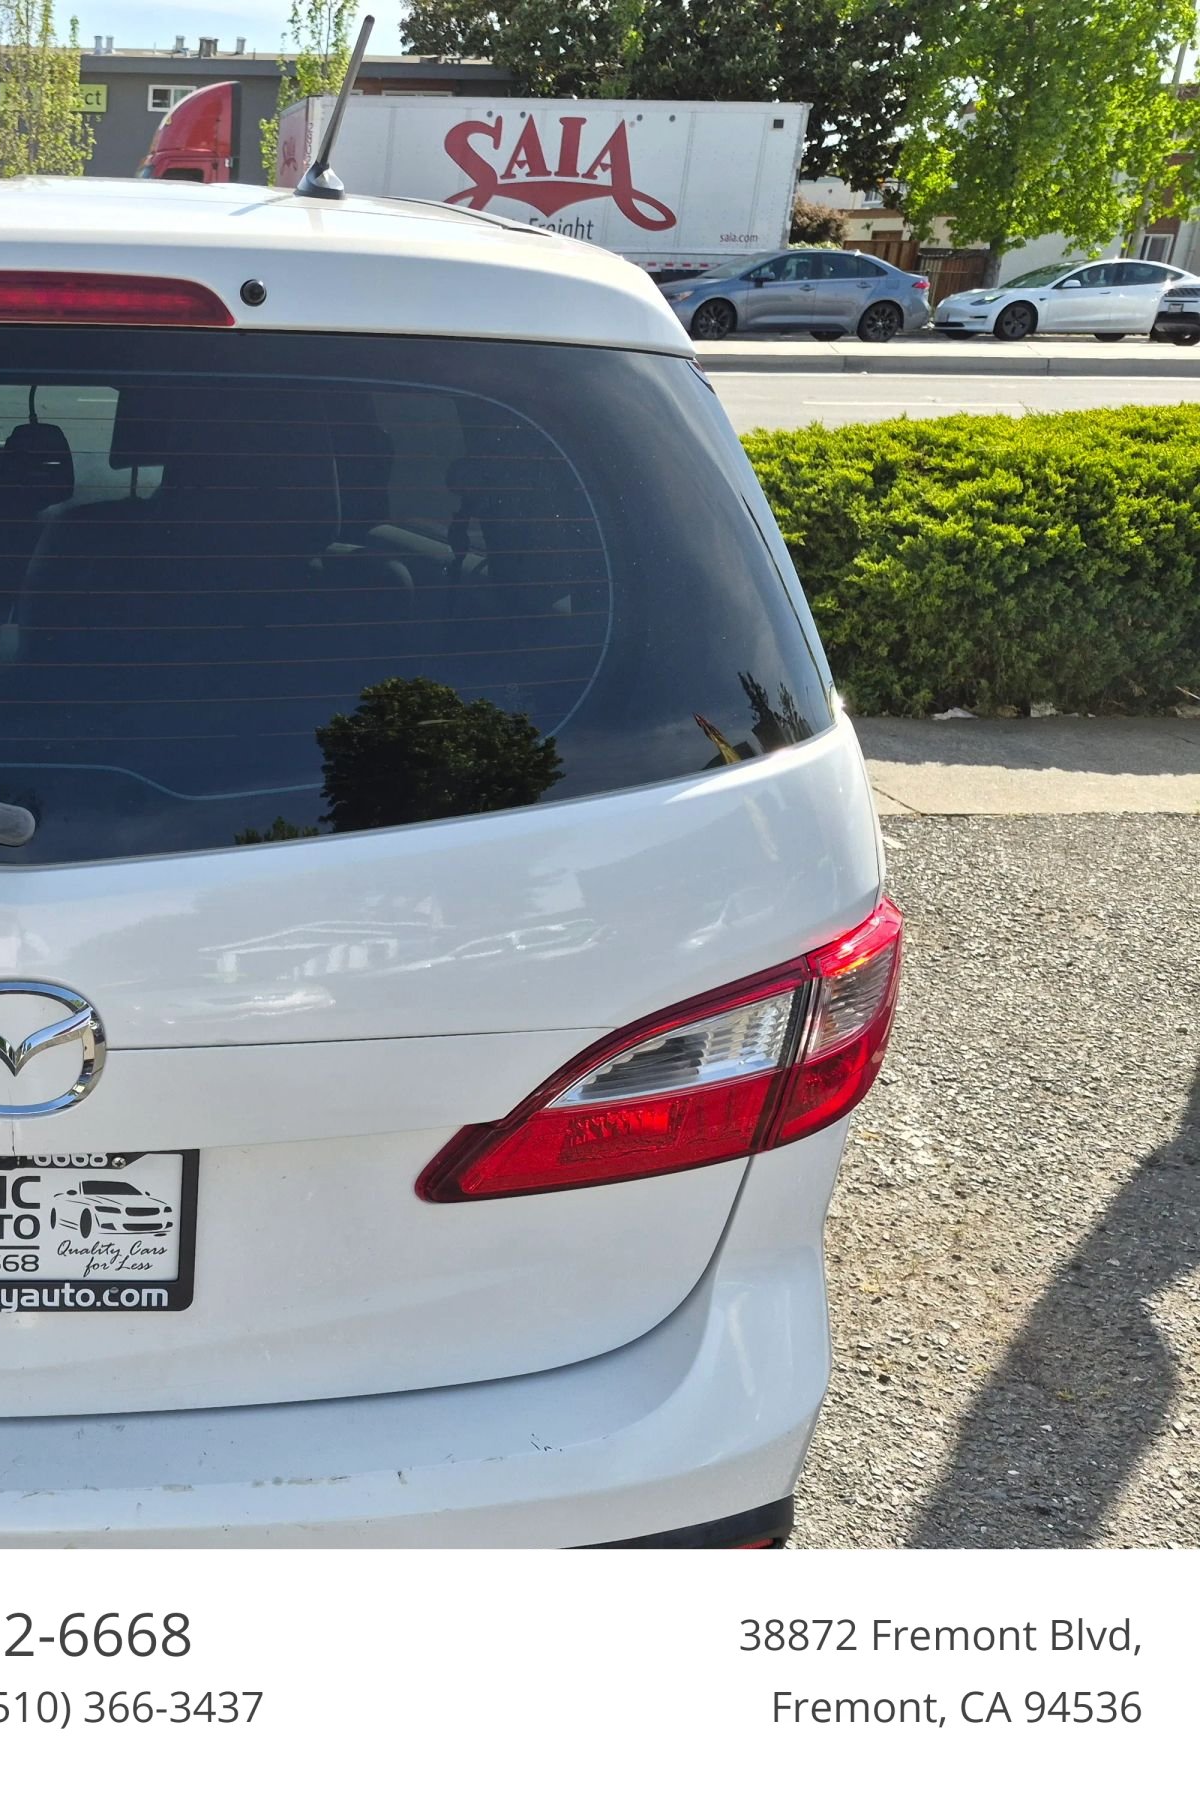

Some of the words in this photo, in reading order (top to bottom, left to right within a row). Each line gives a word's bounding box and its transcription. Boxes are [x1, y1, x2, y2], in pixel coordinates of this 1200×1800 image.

[443, 114, 677, 231] SAIA
[719, 232, 759, 243] saia.com
[56, 1240, 123, 1264] Quality
[129, 1240, 168, 1256] Cars
[83, 1256, 110, 1278] for
[114, 1255, 154, 1272] Less
